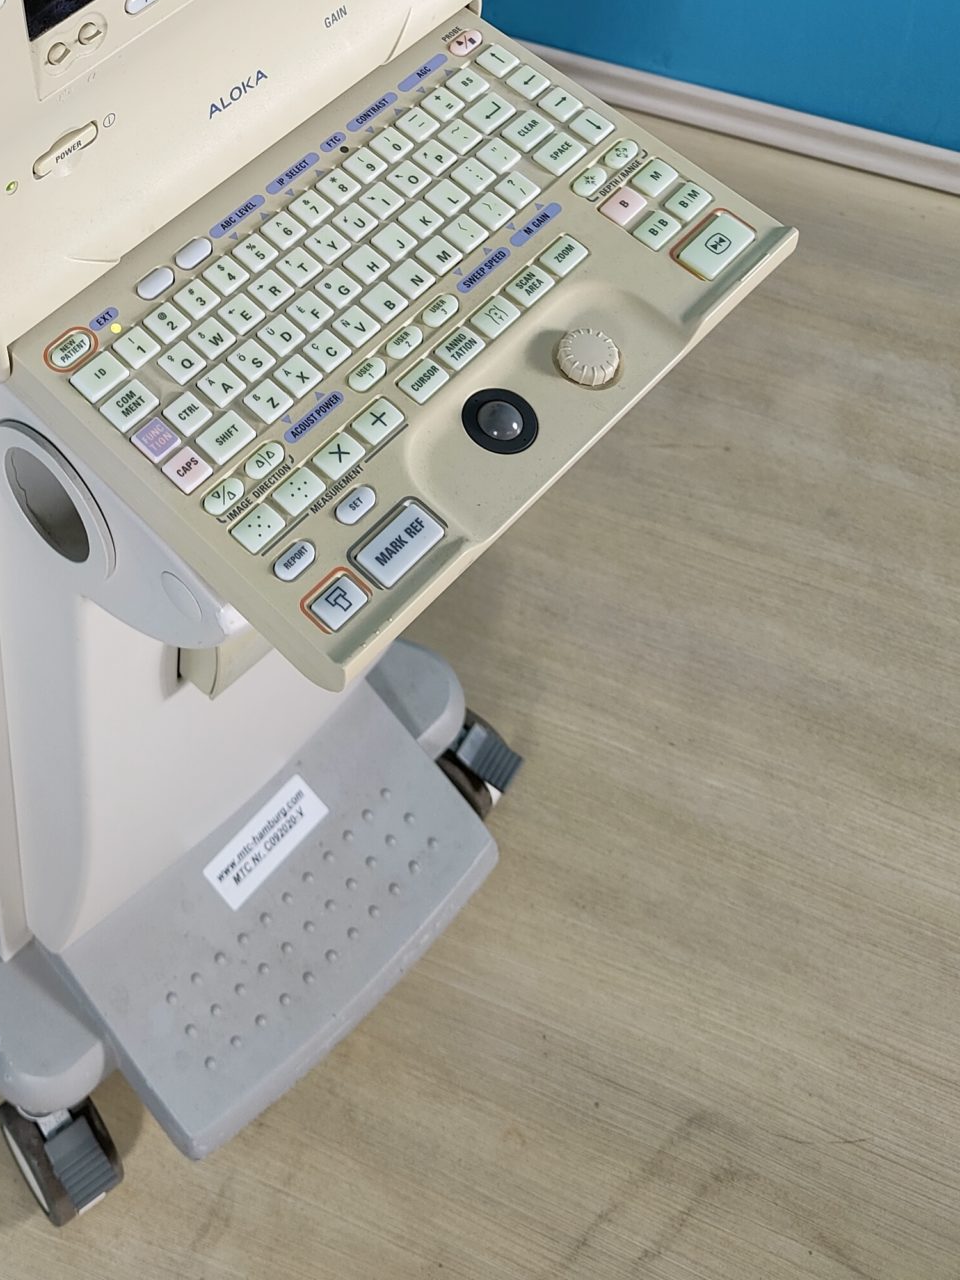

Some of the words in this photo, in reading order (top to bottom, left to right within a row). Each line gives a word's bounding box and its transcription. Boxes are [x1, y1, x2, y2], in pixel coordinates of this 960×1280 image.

[323, 5, 348, 29] GAIN
[441, 26, 463, 42] PROBE
[416, 66, 432, 79] AGC
[461, 77, 474, 87] BS
[208, 69, 269, 120] ALOKA
[355, 97, 390, 126] CONTRAST
[517, 119, 540, 138] CLEAR
[326, 135, 341, 148] FTC
[54, 139, 83, 164] POWER
[549, 140, 573, 161] SPACE
[434, 154, 444, 164] P
[275, 177, 287, 188] IP
[287, 159, 311, 181] SELECT
[366, 163, 376, 172] 9
[599, 177, 620, 197] DEPTH
[622, 160, 642, 180] RANGE
[649, 170, 663, 181] M
[338, 184, 349, 192] 8
[447, 197, 459, 205] L
[619, 199, 630, 209] B
[220, 216, 237, 231] ABC
[235, 201, 257, 219] LEVEL
[309, 206, 320, 215] 7
[353, 218, 366, 229] U
[419, 216, 433, 227] K
[524, 224, 535, 236] M
[531, 211, 551, 230] GAIN
[283, 227, 293, 236] 6
[327, 240, 338, 251] Y
[396, 239, 406, 249] J
[254, 250, 266, 260] 5
[436, 250, 452, 263] M
[553, 243, 576, 264] ZOOM
[297, 262, 308, 273] T
[366, 261, 380, 273] H
[462, 265, 487, 289] SWEEP
[484, 250, 507, 271] SPEED
[227, 273, 236, 281] 4
[410, 274, 425, 287] N
[515, 270, 537, 291] SCAN
[268, 286, 282, 297] R
[337, 285, 351, 296] G
[524, 278, 545, 297] AREA
[195, 297, 207, 307] 3
[383, 300, 397, 311] B
[428, 298, 447, 314] USER
[96, 311, 114, 327] EXT
[240, 310, 253, 321] E
[310, 309, 322, 320] F
[166, 321, 178, 331] 2
[354, 321, 367, 334] V
[208, 333, 225, 346] W
[280, 331, 293, 342] D
[392, 331, 411, 347] USER
[444, 332, 467, 354] ANNO
[59, 338, 77, 354] NEW
[60, 339, 87, 364] PATIENT
[136, 345, 147, 354] 1
[325, 346, 338, 357] C
[451, 337, 478, 362] TATION
[181, 358, 195, 369] Q
[251, 357, 264, 369] S
[94, 367, 107, 380] ID
[355, 362, 374, 378] USER
[296, 371, 310, 384] X
[410, 364, 440, 392] CURSOR
[220, 382, 234, 394] A
[115, 390, 137, 409] COM
[266, 396, 280, 409] Z
[121, 396, 146, 418] MENT
[177, 403, 200, 421] CTRL
[290, 414, 318, 439] ACOUST
[316, 394, 341, 418] POWER
[142, 423, 164, 444] FUNC
[215, 424, 240, 447] SHIFT
[150, 431, 172, 452] TION
[176, 457, 199, 478] CAPS
[226, 498, 253, 522] IMAGE
[251, 464, 291, 499] DIRECTION
[310, 464, 365, 515] MEASUREMENT
[348, 497, 364, 512] SET
[374, 534, 408, 567] MARK
[404, 517, 426, 540] REF
[282, 545, 309, 571] REPORT
[232, 861, 253, 886] MTC
